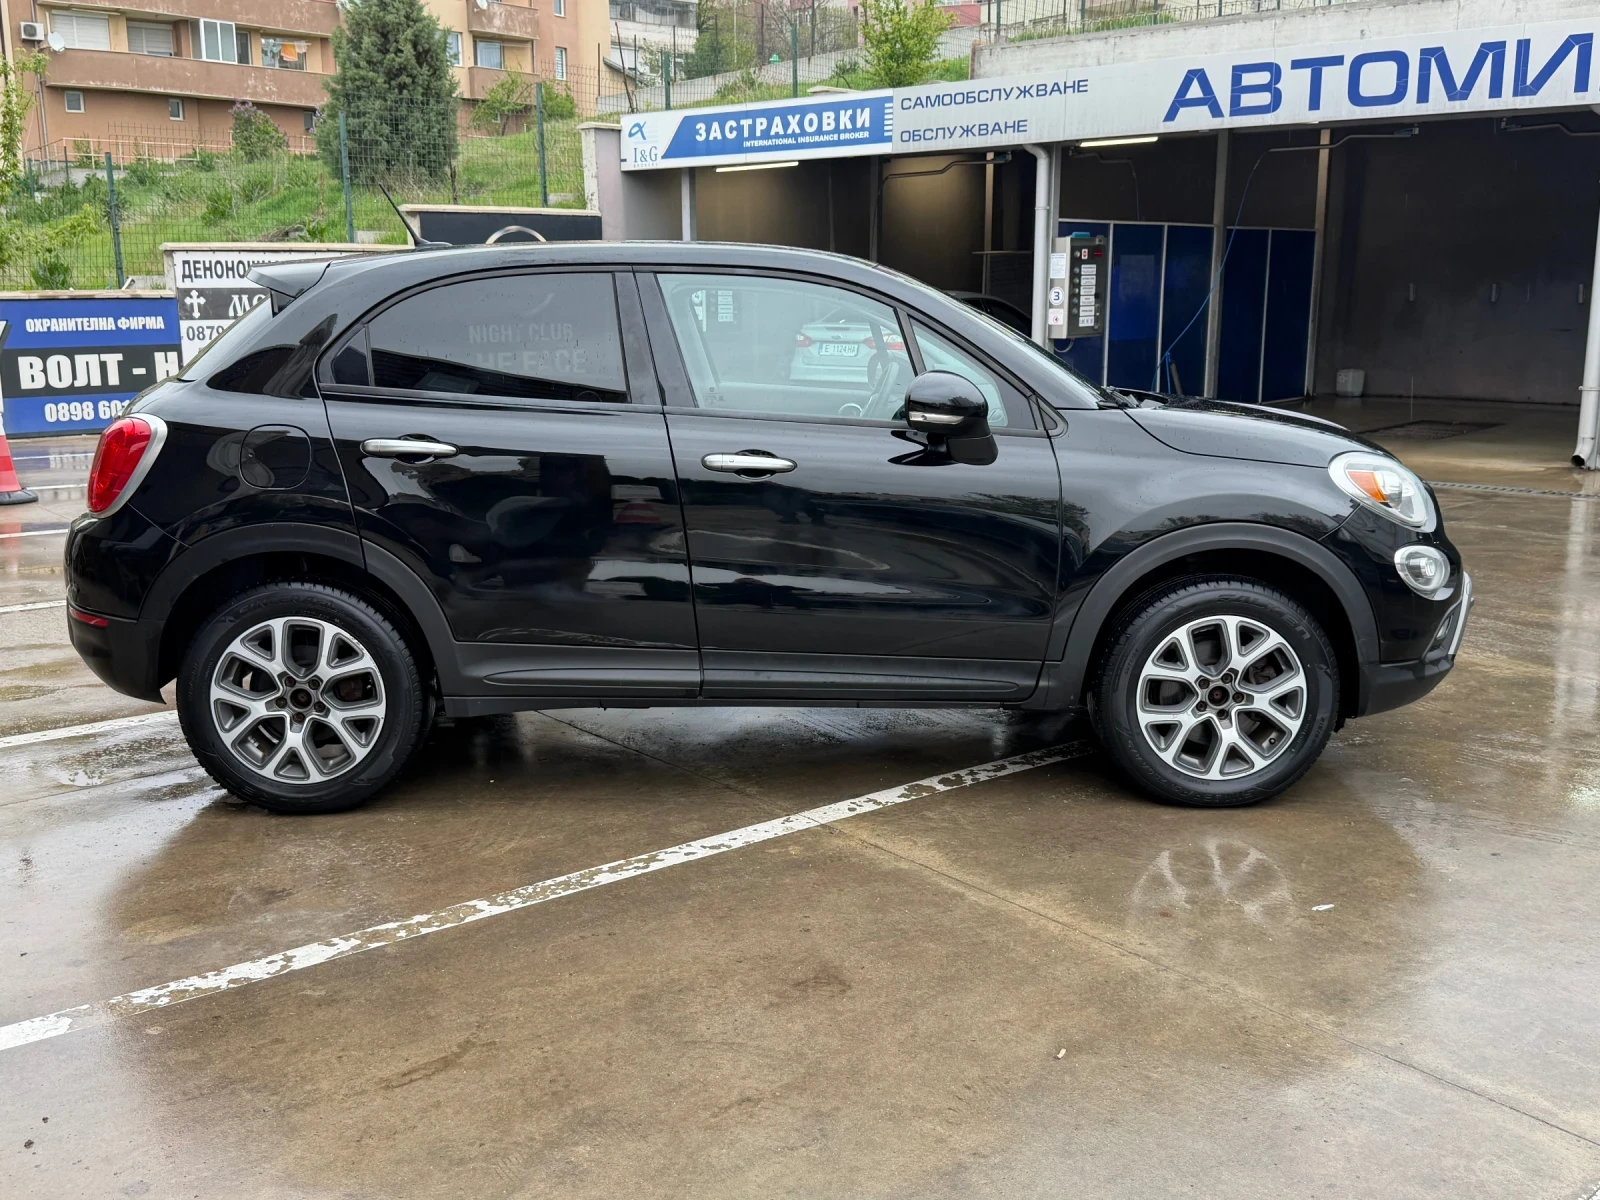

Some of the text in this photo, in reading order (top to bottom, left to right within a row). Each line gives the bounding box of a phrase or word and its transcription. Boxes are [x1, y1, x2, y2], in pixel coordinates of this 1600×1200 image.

[1162, 33, 1600, 122] АВТОМИ
[901, 79, 1089, 111] САМООБСЛУЖВАНЕ
[695, 107, 870, 141] ЗАСТРАХОВКИ
[900, 119, 1028, 143] ОБСЛУЖВАНЕ
[743, 131, 870, 147] INTERNATIONAL INSURANCE BROKER
[633, 145, 658, 163] I&G
[1053, 291, 1060, 301] 3
[25, 315, 165, 333] ОХРАНИТЕЛНА ФИРМА
[18, 353, 123, 390] ВОЛТ
[132, 367, 146, 375] -
[44, 401, 95, 423] 0898
